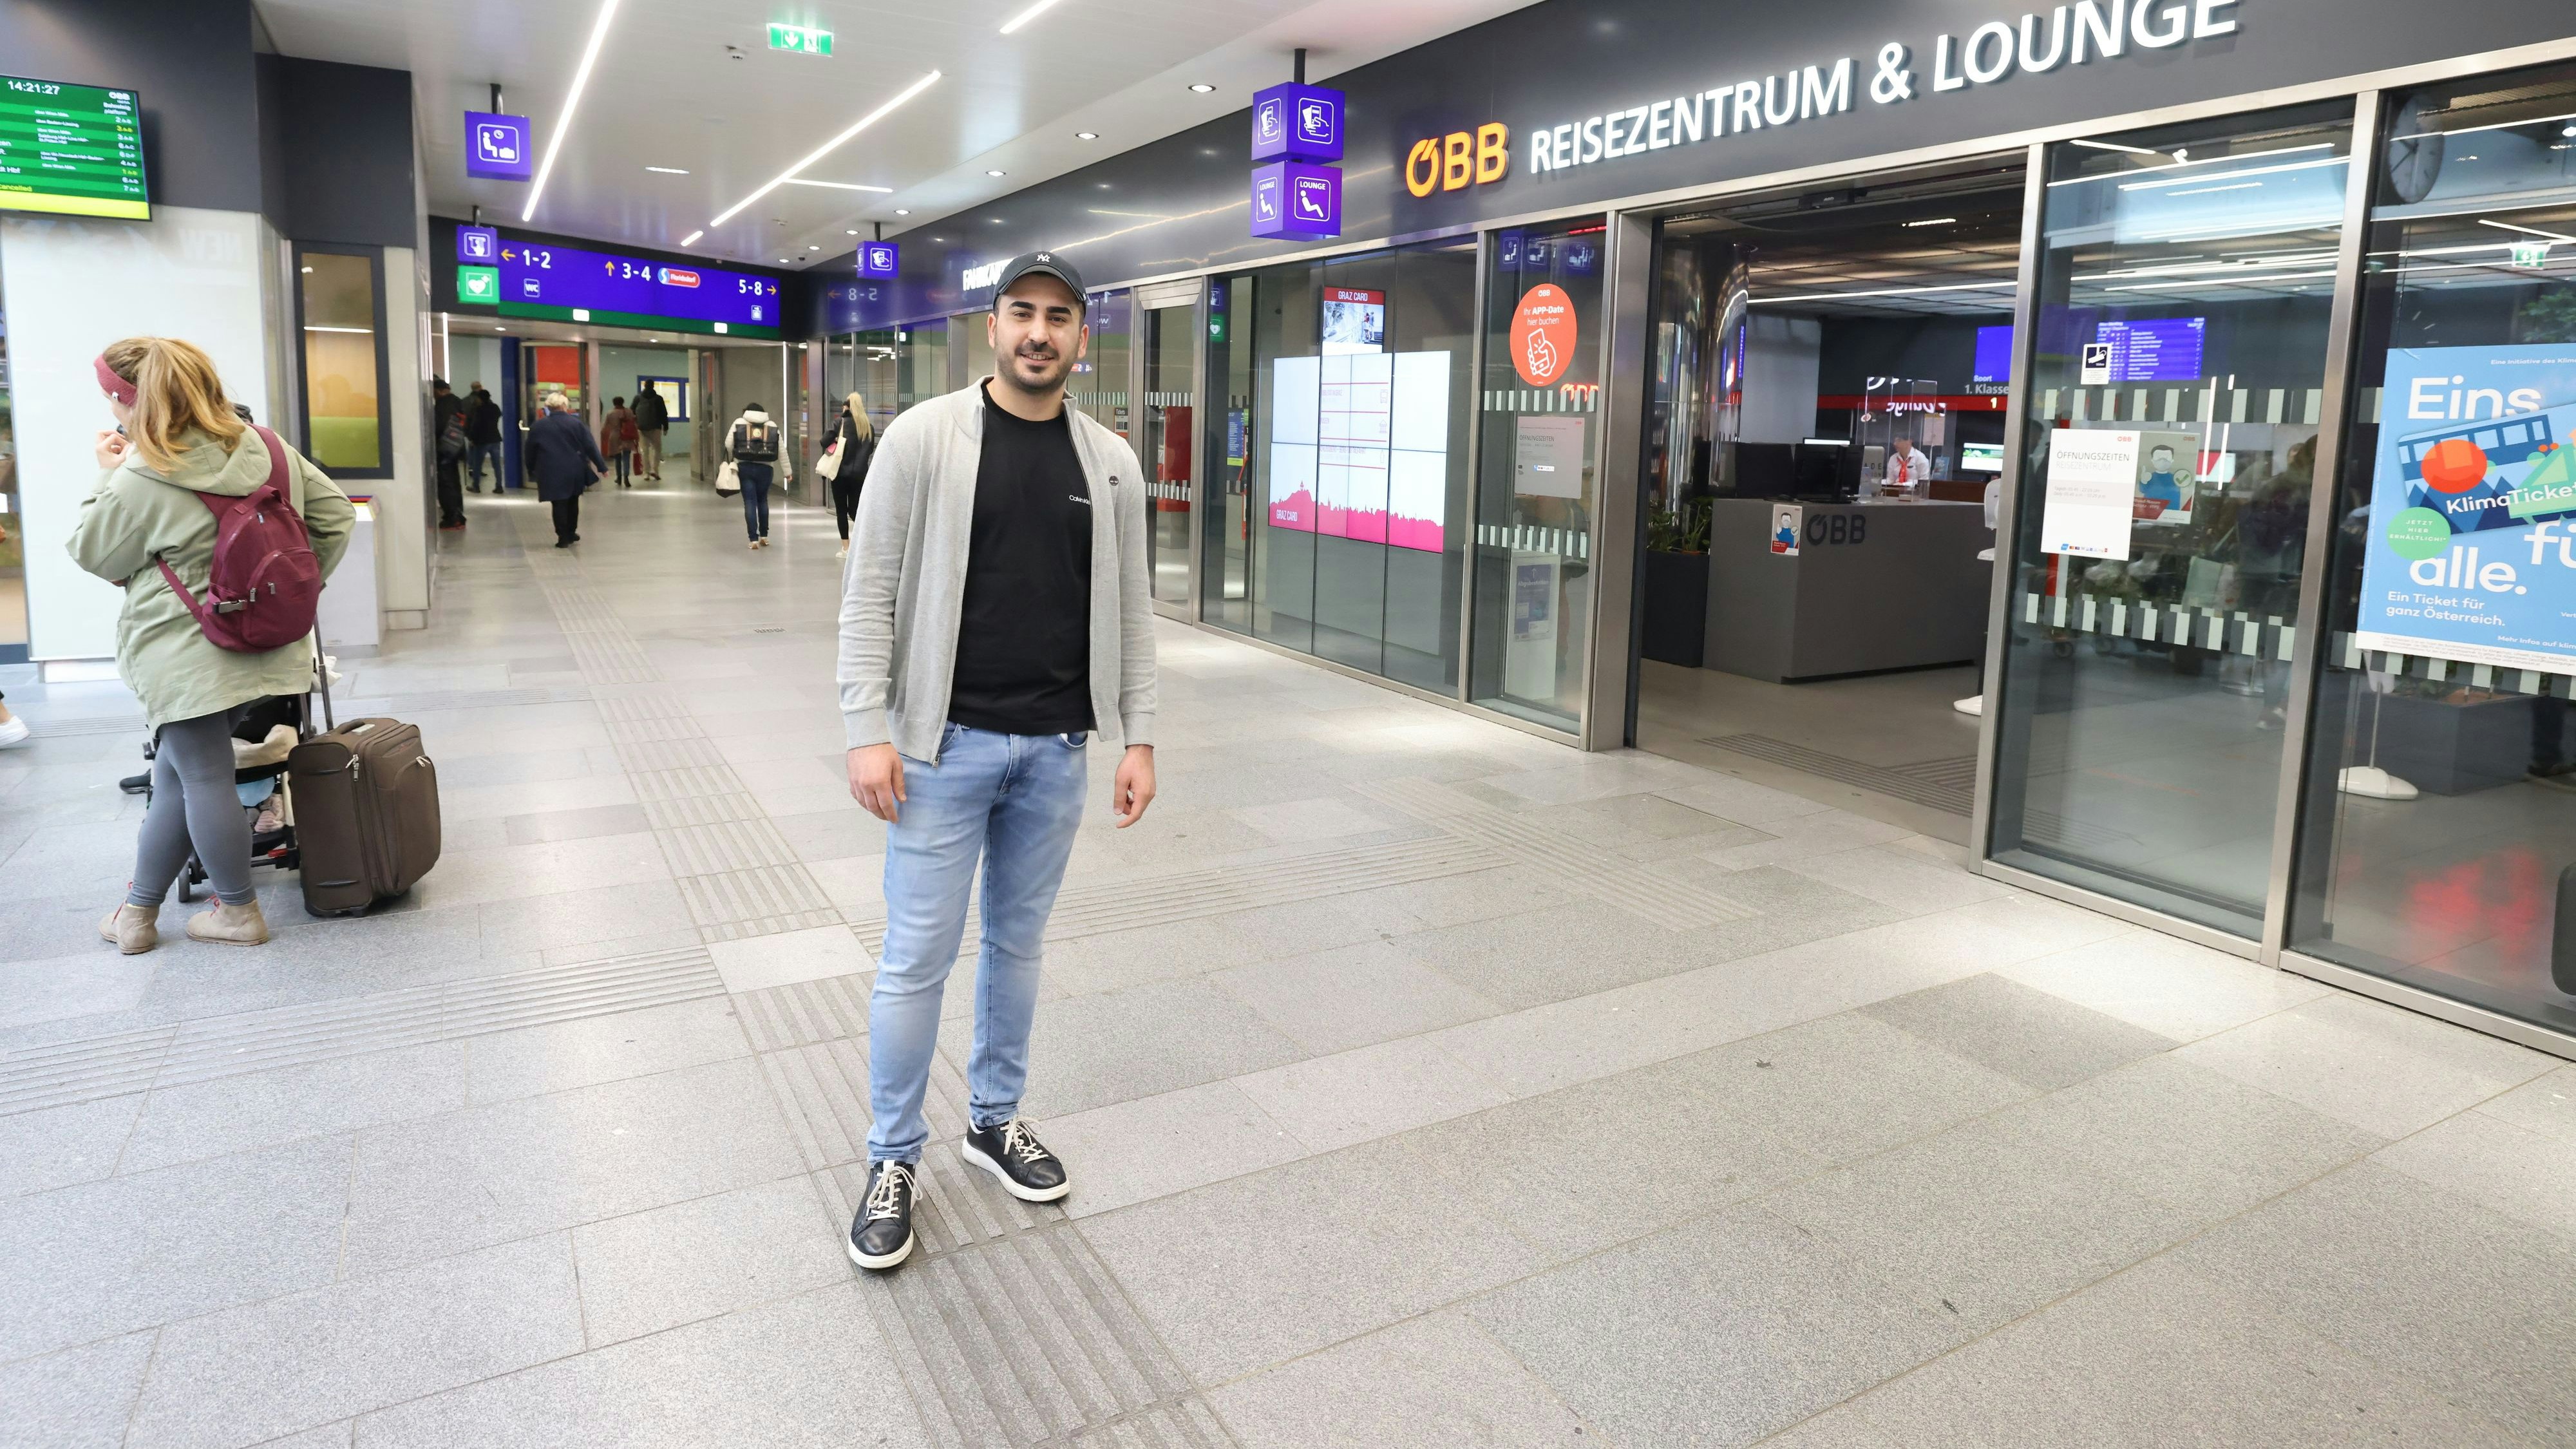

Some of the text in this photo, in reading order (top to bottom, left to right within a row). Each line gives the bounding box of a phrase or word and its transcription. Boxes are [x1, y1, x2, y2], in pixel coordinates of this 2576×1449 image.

[8, 80, 61, 95] 14:21:27
[1405, 0, 2237, 198] ÖBB REISEZENTRUM & LOUNGE
[1259, 181, 1275, 191] LOUNGE
[1300, 180, 1327, 191] LOUNGE
[522, 249, 551, 269] 1-2
[622, 262, 651, 282] 3-4
[525, 283, 539, 293] WC
[738, 279, 762, 296] 5-8
[1338, 290, 1368, 301] GRAZ CARD
[1532, 305, 1564, 315] APP-Date
[1539, 317, 1559, 326] buchen
[1964, 383, 2009, 394] 1. Klasse
[1990, 397, 1997, 409] 1
[2407, 374, 2542, 420] Eins
[2056, 451, 2130, 462] ÖFFNUNGSZEITEN
[2056, 460, 2111, 471] REISEZENTRUM
[1069, 495, 1084, 503] Calvin
[1276, 509, 1298, 522] GRAZ CARD
[1806, 514, 1866, 546] ÖBB
[2409, 545, 2528, 595] alle.
[2387, 591, 2485, 610] Ein Ticket für
[2385, 605, 2506, 627] ganz Österreich.
[2497, 635, 2519, 643] Mehr
[2519, 638, 2541, 646] Infos
